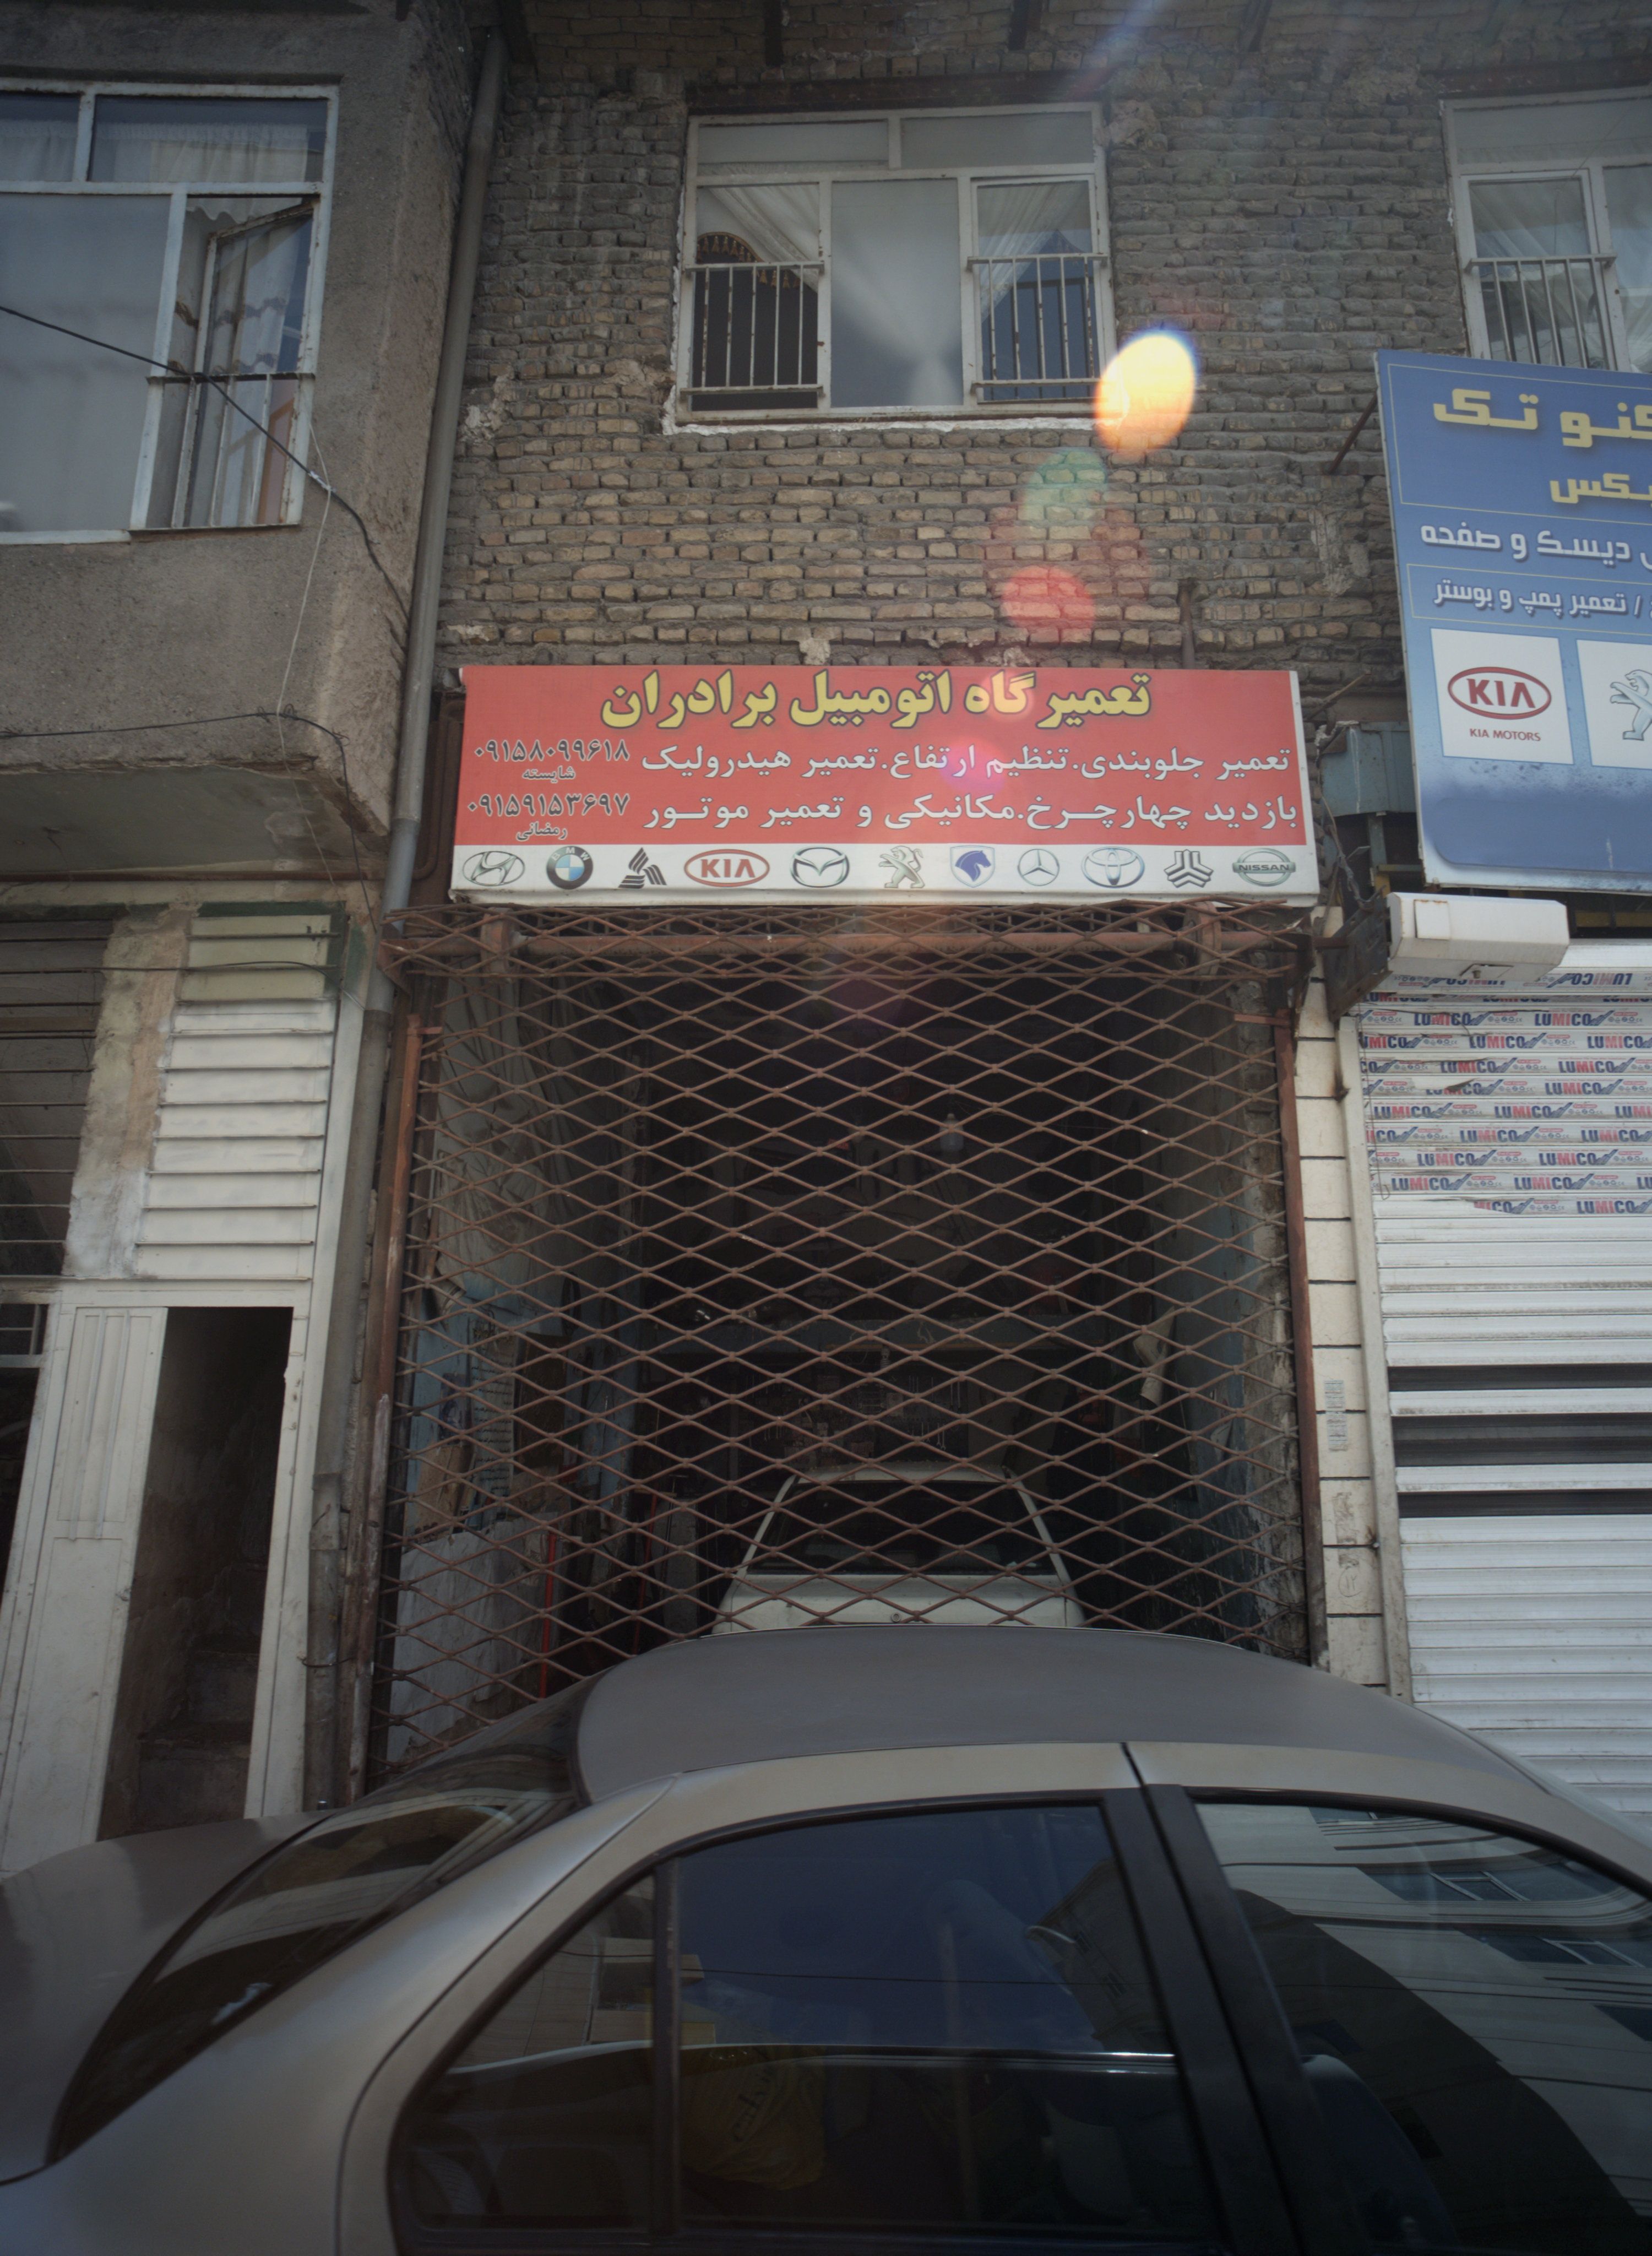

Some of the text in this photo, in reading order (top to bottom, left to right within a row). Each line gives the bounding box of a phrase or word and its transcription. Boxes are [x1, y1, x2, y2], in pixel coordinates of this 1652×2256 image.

[1433, 388, 1539, 430] تک
[1550, 473, 1652, 506] کس
[1421, 522, 1501, 550] صفحه
[1510, 533, 1528, 560] و
[1536, 530, 1631, 565] دیسک
[1434, 579, 1492, 609] بوستر
[1499, 589, 1512, 610] و
[1519, 592, 1562, 616] پمپ
[1569, 593, 1626, 615] تعمیر
[601, 668, 777, 729] برادران
[790, 668, 952, 729] اتومبیل
[1466, 679, 1535, 708] KIA
[1470, 728, 1541, 742] KIA MOTORS
[474, 739, 630, 762] ۰۹۱۵۸۰۹۹۶۱۸
[642, 745, 792, 778] هیدرولیک
[1215, 749, 1291, 780] تعمیر
[522, 765, 575, 783] شایسته
[468, 793, 630, 817] ۰۹۱۵۹۱۵۳۶۹۷
[759, 796, 845, 828] تعمیر
[1204, 795, 1297, 829] بازدید
[856, 804, 872, 827] و
[515, 821, 568, 841] رمضانی
[552, 846, 591, 862] BMW
[700, 856, 757, 877] KIA
[1237, 863, 1291, 873] NISSAN
[1414, 1012, 1471, 1026] LUMICO
[1535, 1013, 1593, 1026] LUMICO
[1469, 1036, 1525, 1049] LUMICO
[1587, 1035, 1644, 1049] LUMICO
[1441, 1061, 1497, 1073] LUMICO
[1558, 1061, 1615, 1073] LUMICO
[1545, 1082, 1602, 1095] LUMICO
[1374, 1106, 1432, 1119] LUMICO
[1495, 1106, 1552, 1118] LUMICO
[1460, 1130, 1518, 1143] LUMICO
[1581, 1130, 1638, 1142] LUMICO
[1417, 1153, 1475, 1166] LUMICO
[1539, 1153, 1597, 1165] LUMICO
[1391, 1177, 1449, 1190] LUMICO
[1514, 1177, 1572, 1190] LUMICO
[1577, 1200, 1635, 1214] LUMICO
